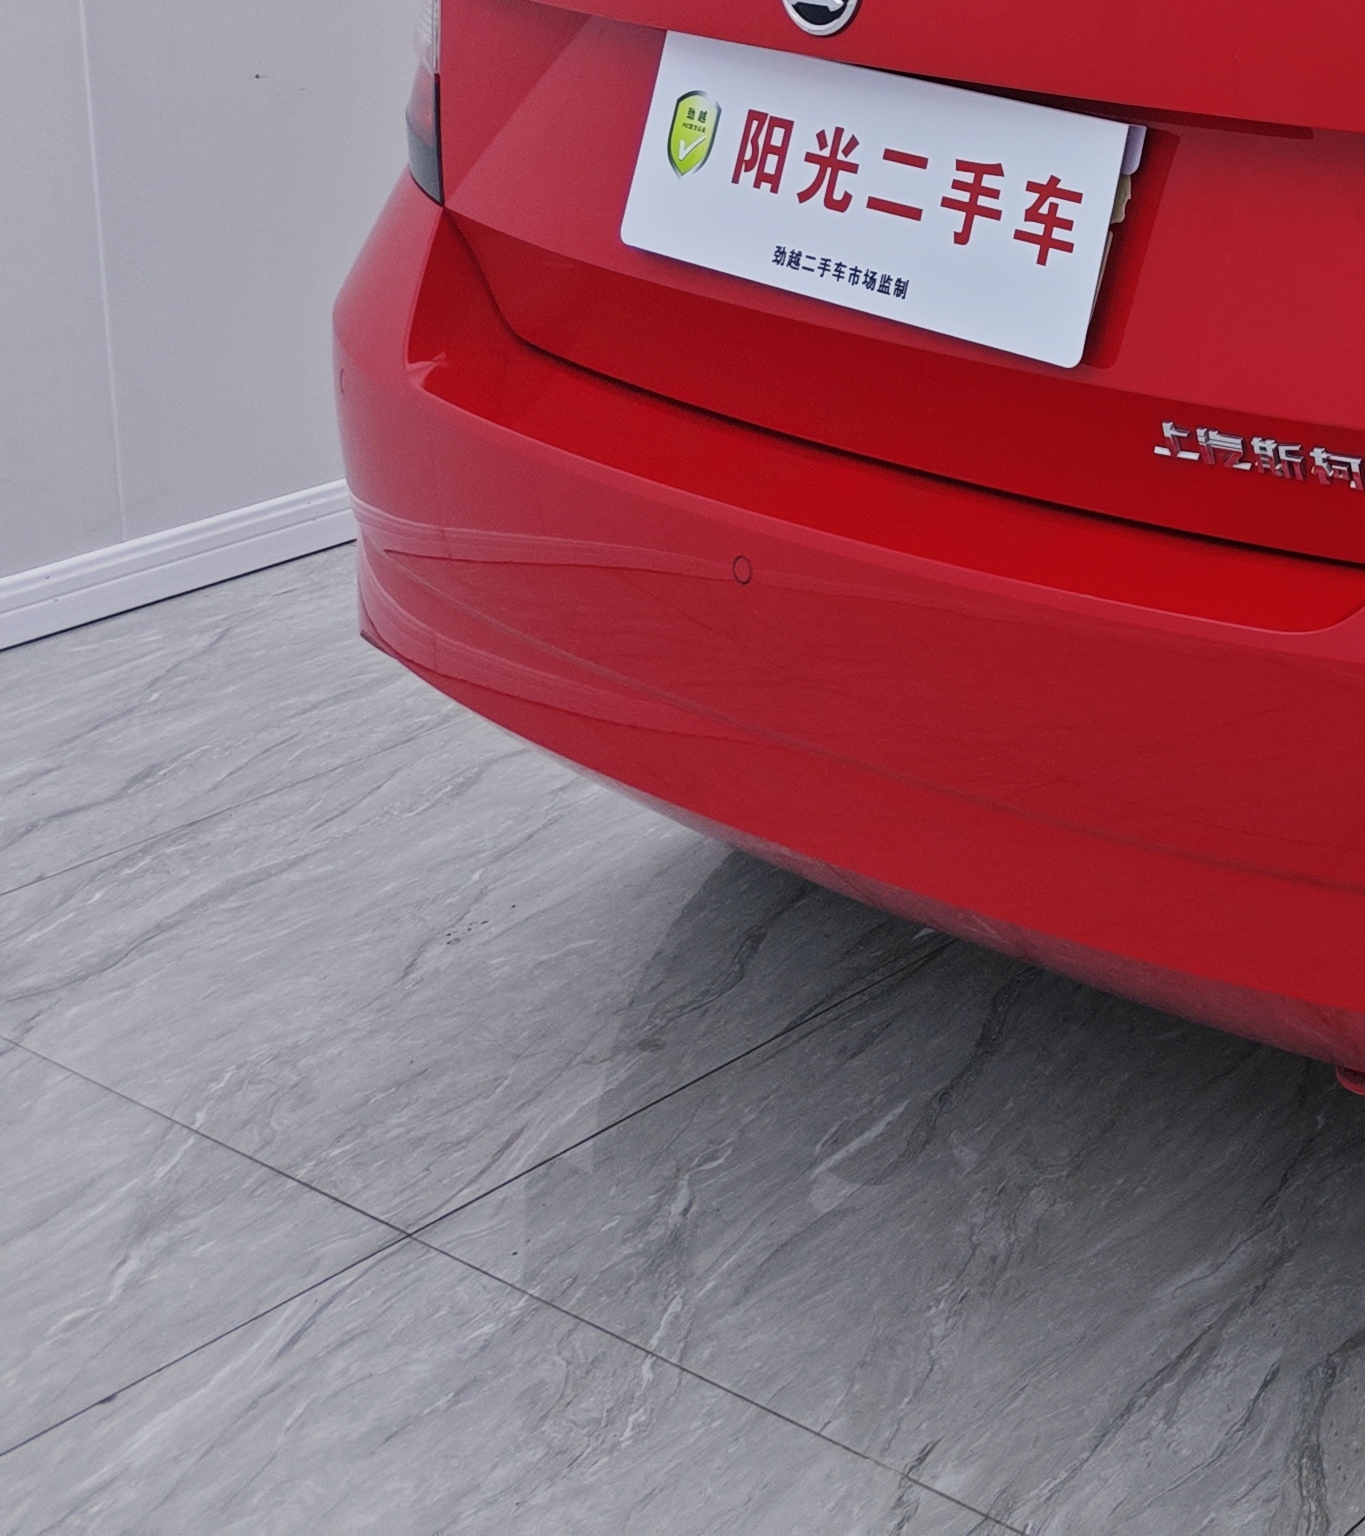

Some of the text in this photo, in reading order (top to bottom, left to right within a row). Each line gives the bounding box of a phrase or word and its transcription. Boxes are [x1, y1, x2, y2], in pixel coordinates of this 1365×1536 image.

[731, 109, 1084, 267] 阳光二手车
[772, 245, 910, 300] 劲越二手车市场监制
